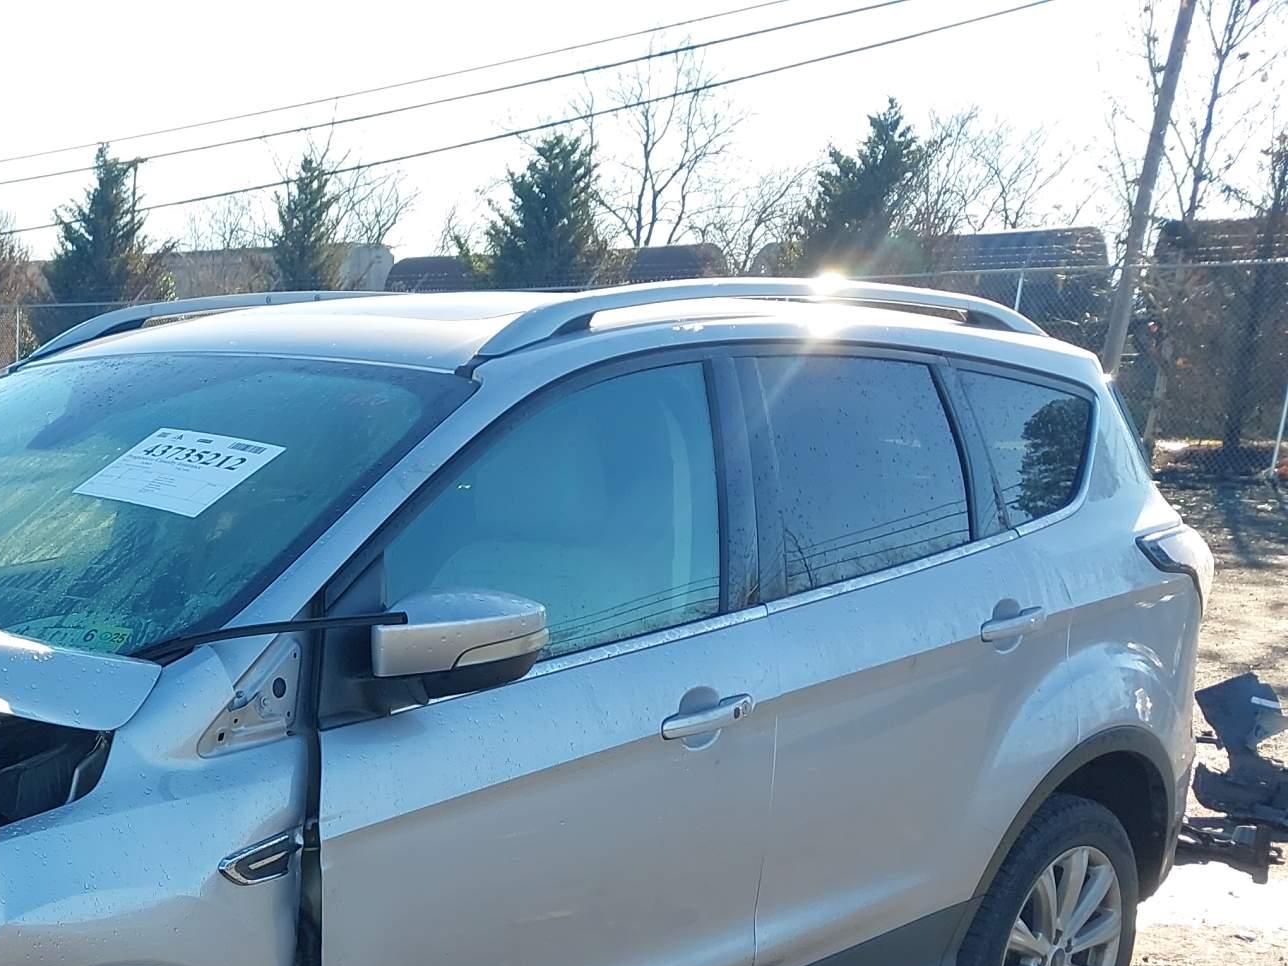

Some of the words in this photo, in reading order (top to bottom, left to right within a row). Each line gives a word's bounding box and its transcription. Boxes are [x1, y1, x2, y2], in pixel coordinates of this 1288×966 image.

[143, 443, 247, 470] 43735212
[83, 629, 98, 642] 6
[110, 632, 127, 644] 25
